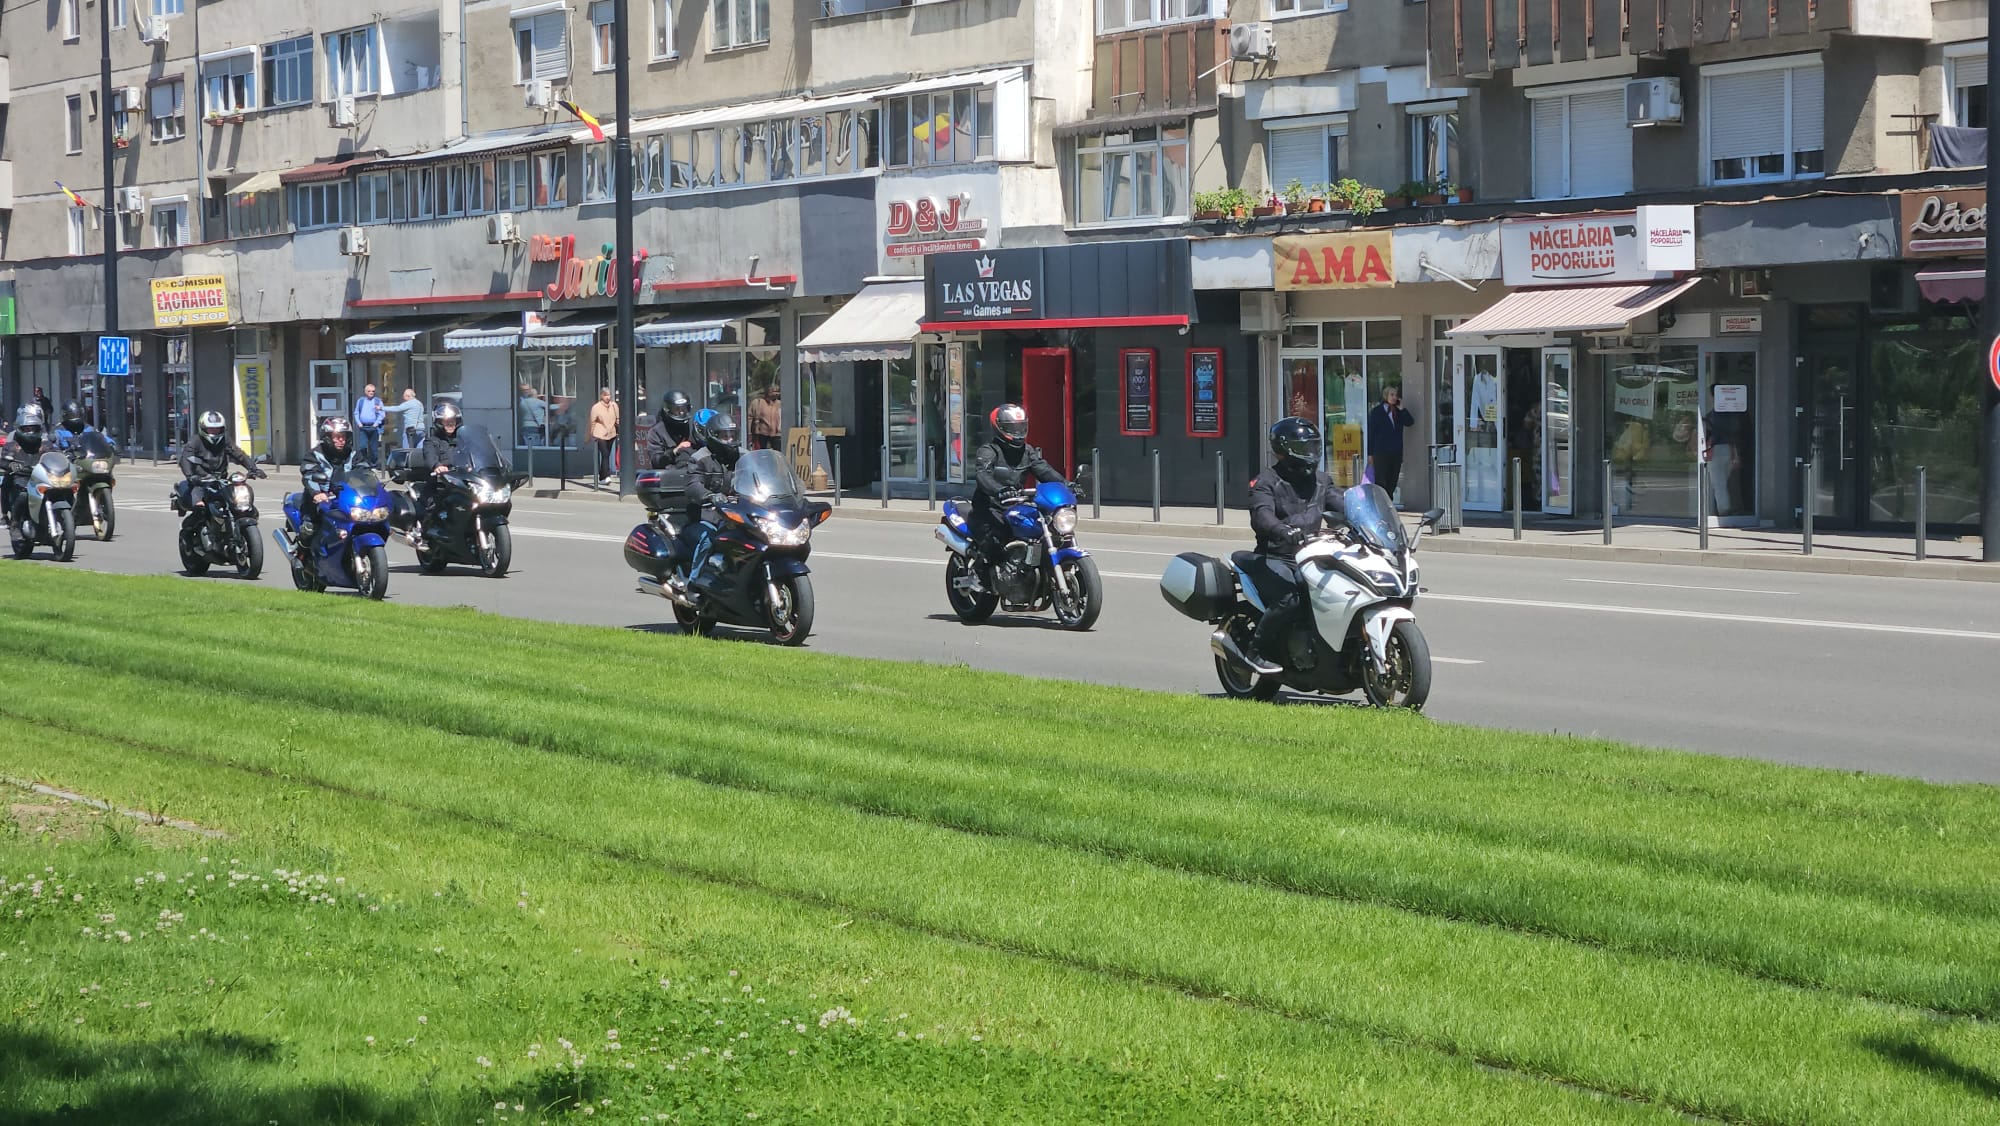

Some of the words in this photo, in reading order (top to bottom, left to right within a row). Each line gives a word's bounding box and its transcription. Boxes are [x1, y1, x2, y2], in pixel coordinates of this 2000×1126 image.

[1529, 223, 1613, 250] MĂCELĂRIA
[1650, 227, 1683, 237] MĂCELĂRIA
[956, 241, 973, 250] femei
[1290, 244, 1392, 285] AMA
[1531, 250, 1615, 271] POPORULUI
[170, 278, 222, 288] COMISION
[943, 282, 975, 304] LAS
[977, 279, 1032, 303] VEGAS
[156, 289, 224, 312] EXCHANGE
[159, 315, 188, 324] NON
[192, 312, 226, 321] STOP
[973, 304, 1001, 317] Games
